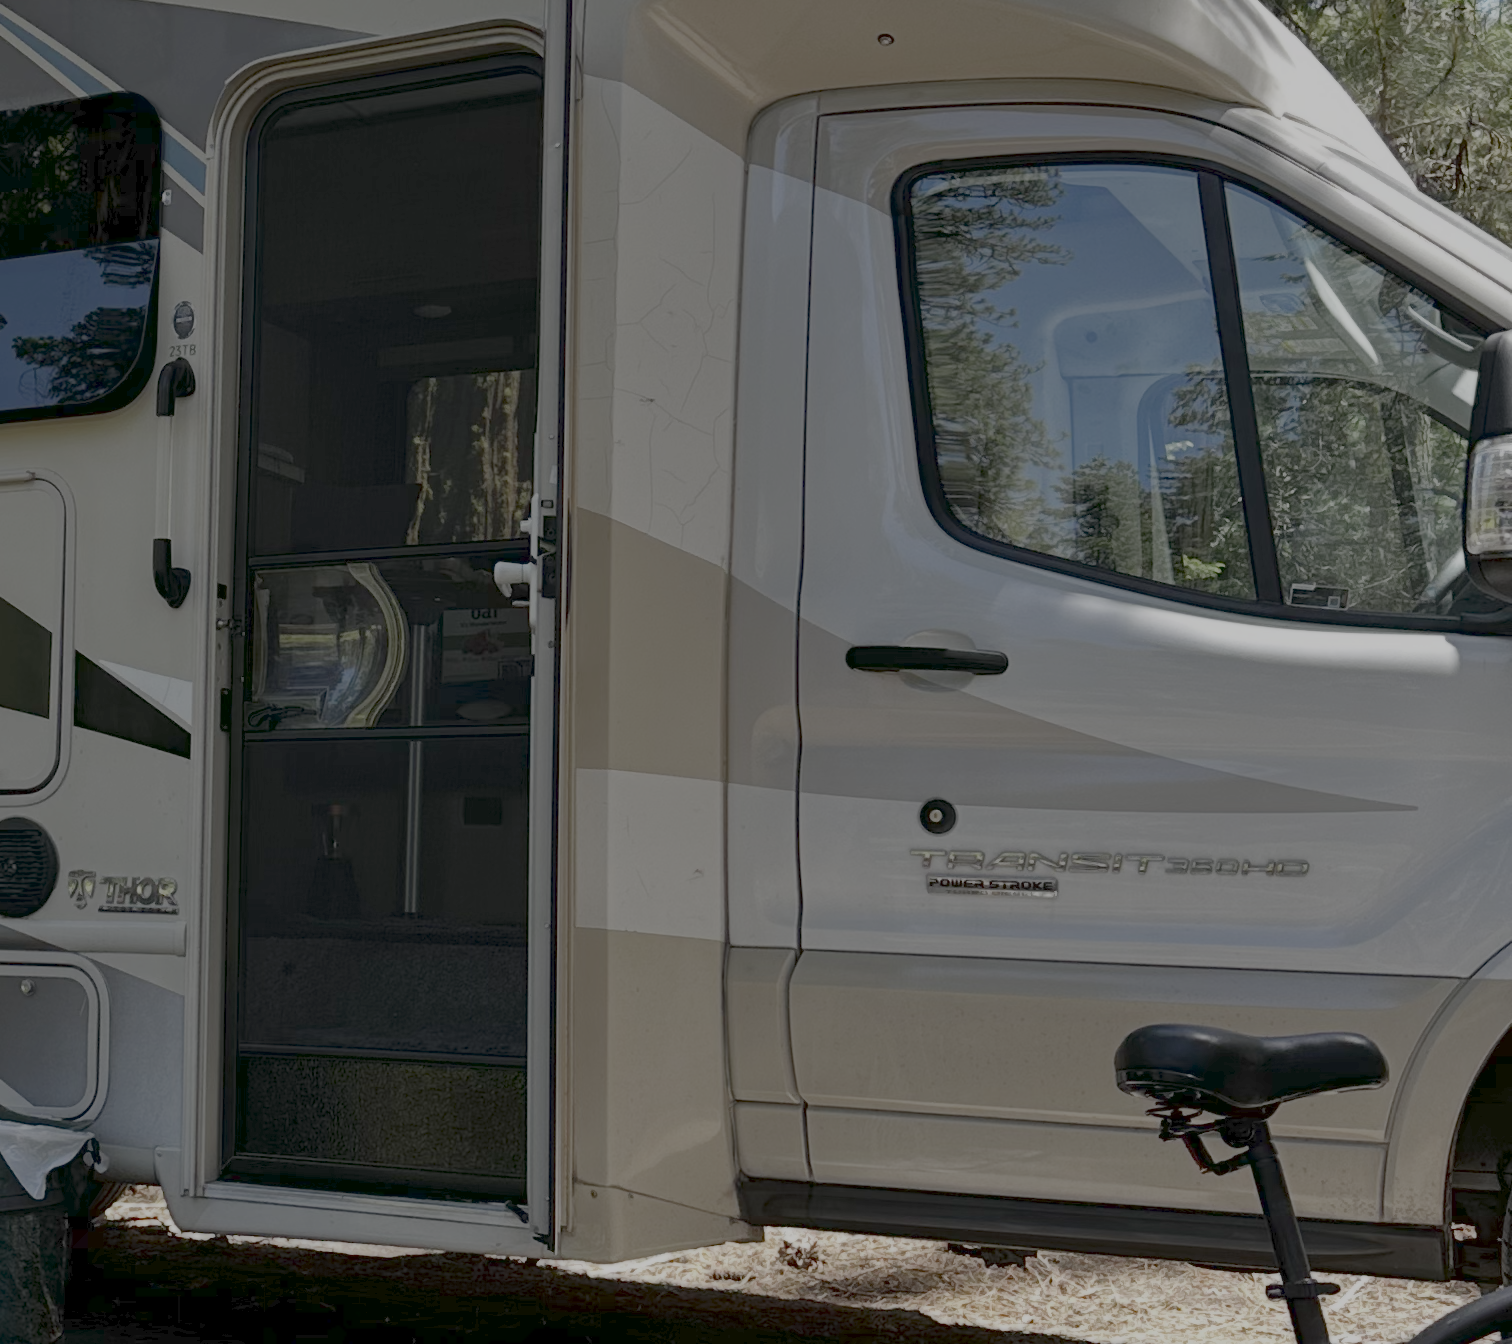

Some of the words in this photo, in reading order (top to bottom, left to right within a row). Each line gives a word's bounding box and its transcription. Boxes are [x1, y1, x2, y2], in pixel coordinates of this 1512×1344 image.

[909, 848, 1165, 877] TRANSIT
[99, 876, 179, 906] THOR
[929, 877, 986, 889] POWER
[989, 879, 1054, 891] STROKE
